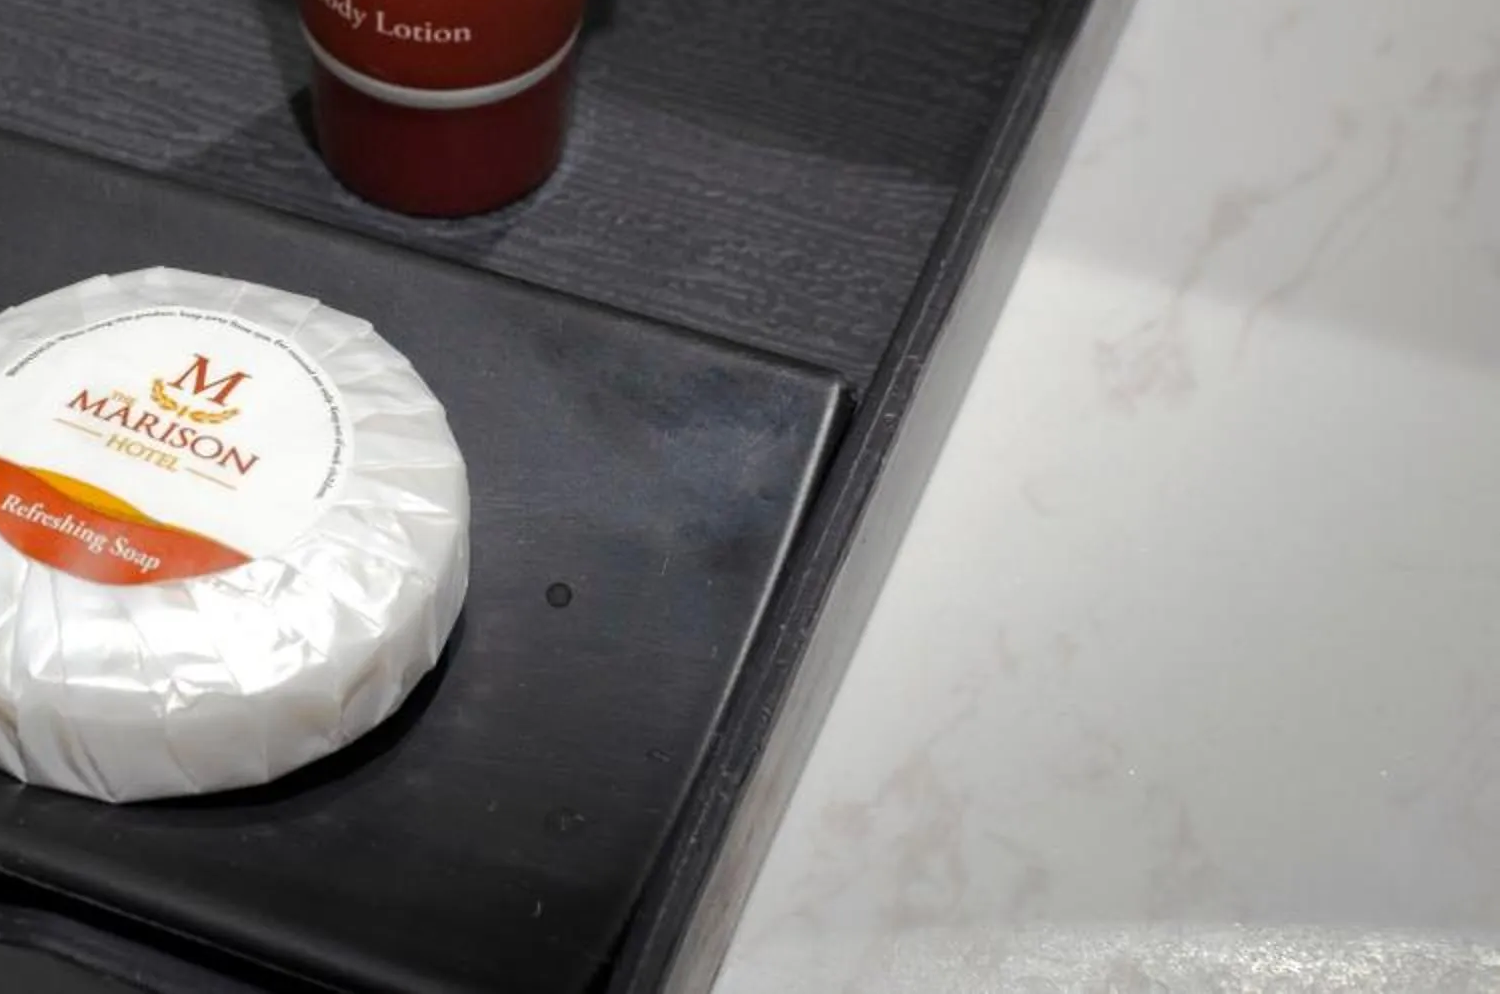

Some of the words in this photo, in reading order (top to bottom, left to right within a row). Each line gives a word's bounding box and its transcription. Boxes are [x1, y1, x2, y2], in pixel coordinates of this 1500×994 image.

[376, 10, 472, 44] Lotion
[167, 353, 252, 407] M
[66, 389, 260, 475] MARISON
[105, 433, 179, 472] HOTEL
[0, 493, 109, 554] Refreshing
[108, 535, 161, 575] Soap
